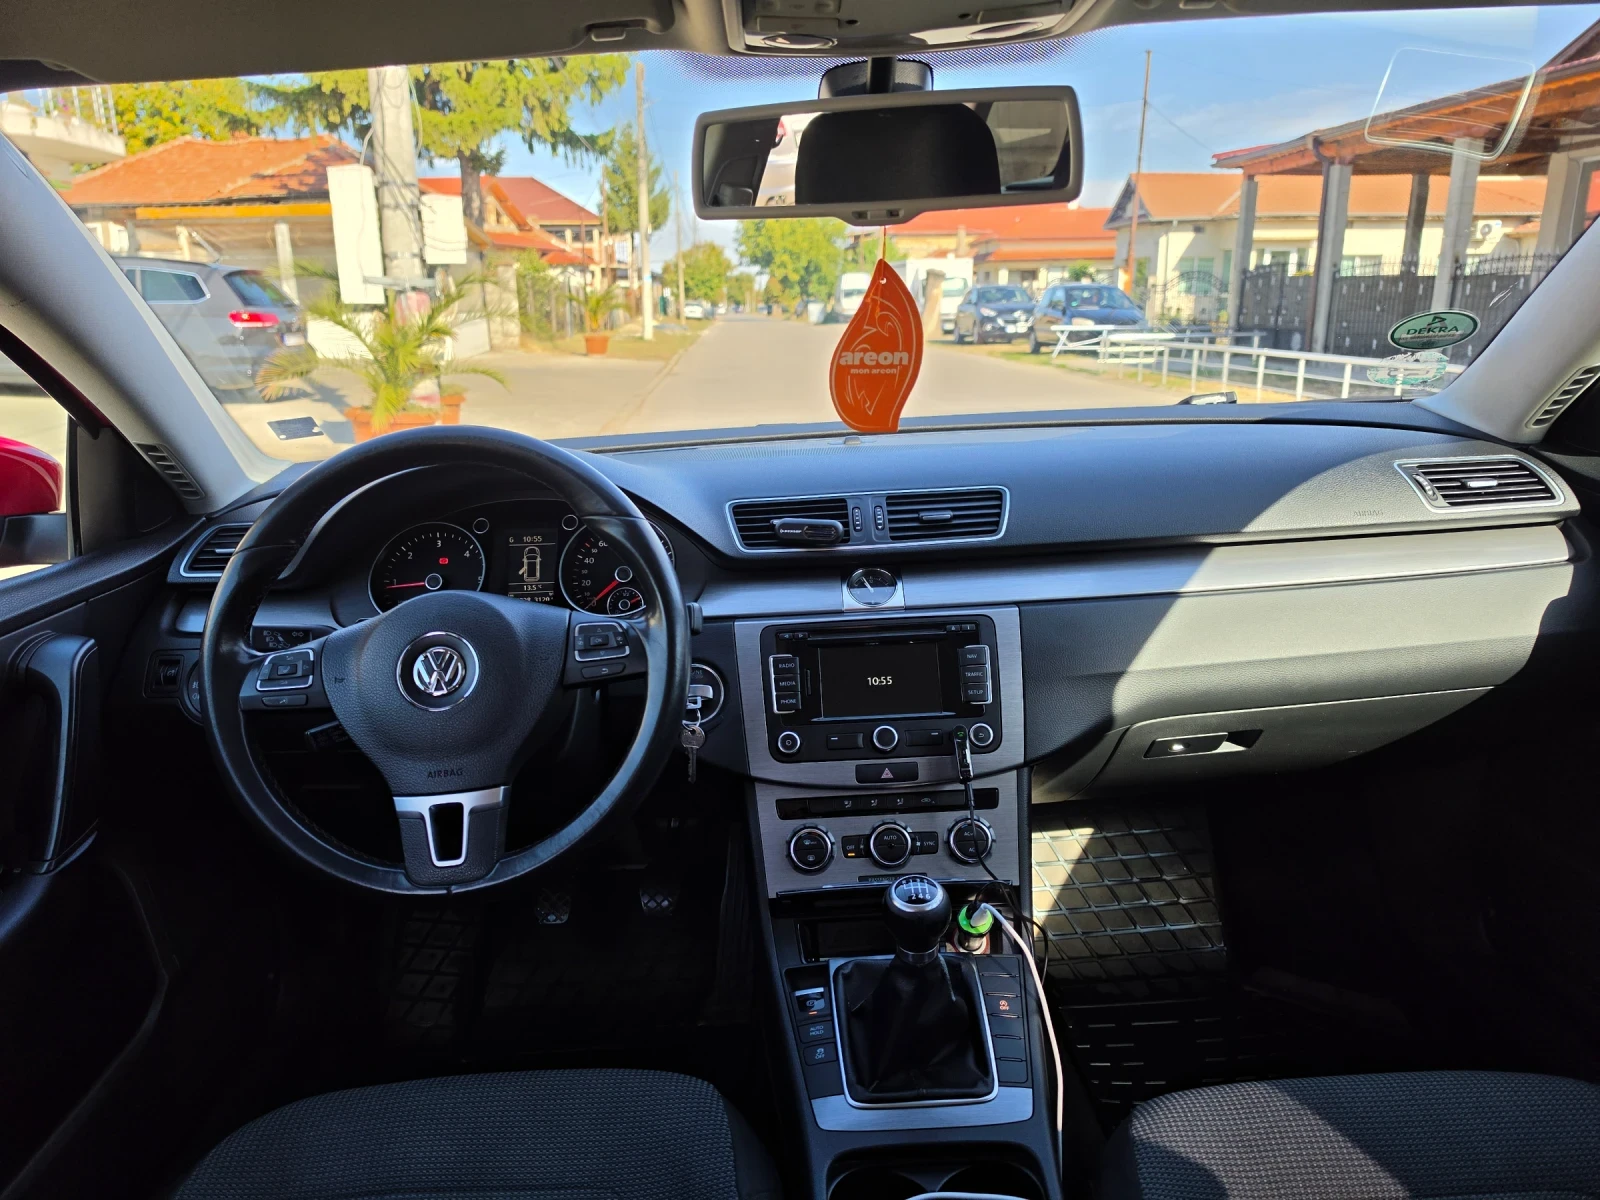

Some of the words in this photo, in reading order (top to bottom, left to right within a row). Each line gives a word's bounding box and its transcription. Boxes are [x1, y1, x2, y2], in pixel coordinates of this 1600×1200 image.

[1406, 325, 1459, 335] DEKRA
[839, 351, 908, 365] areon
[436, 540, 442, 548] 3
[407, 551, 413, 560] 2
[463, 550, 470, 558] 4
[867, 676, 892, 686] 10:55
[427, 769, 463, 779] AIRBAG
